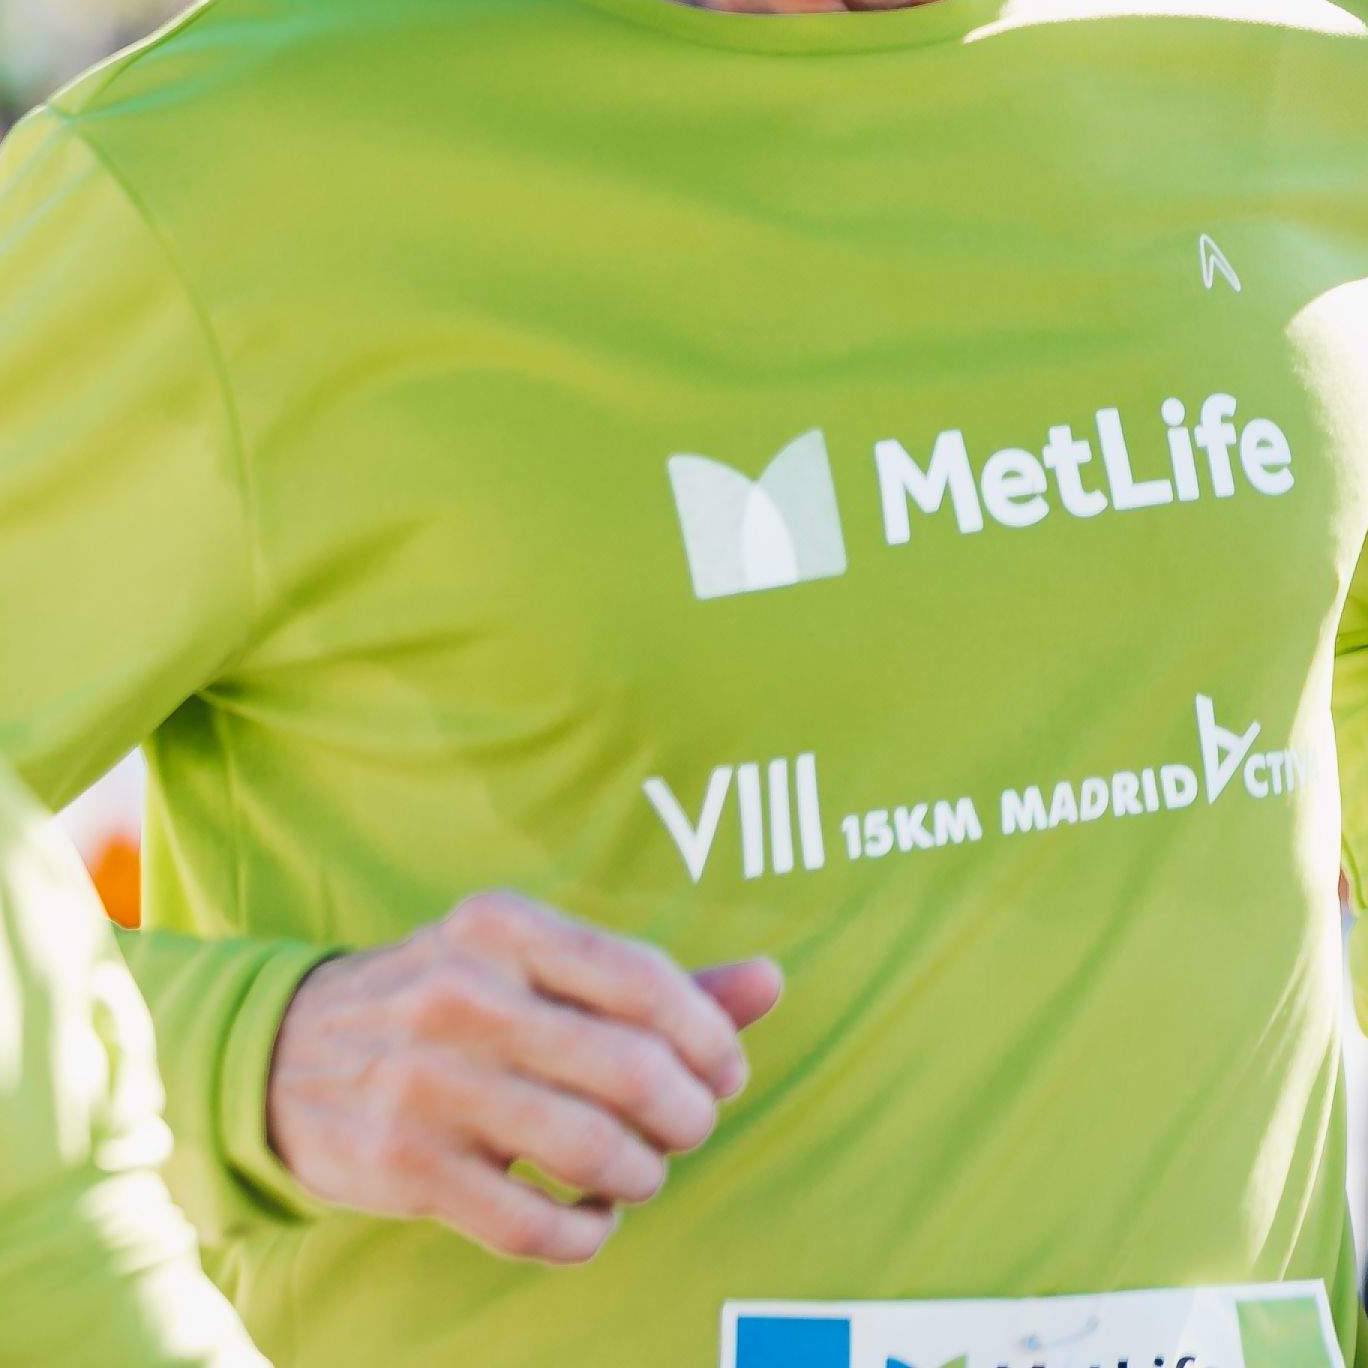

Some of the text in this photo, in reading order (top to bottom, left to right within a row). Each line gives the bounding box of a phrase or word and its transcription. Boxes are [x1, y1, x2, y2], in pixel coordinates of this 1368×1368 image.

[874, 393, 1295, 545] MetLife
[643, 751, 825, 884] VIII
[842, 797, 982, 860] 15KM
[1001, 764, 1198, 835] MADRID
